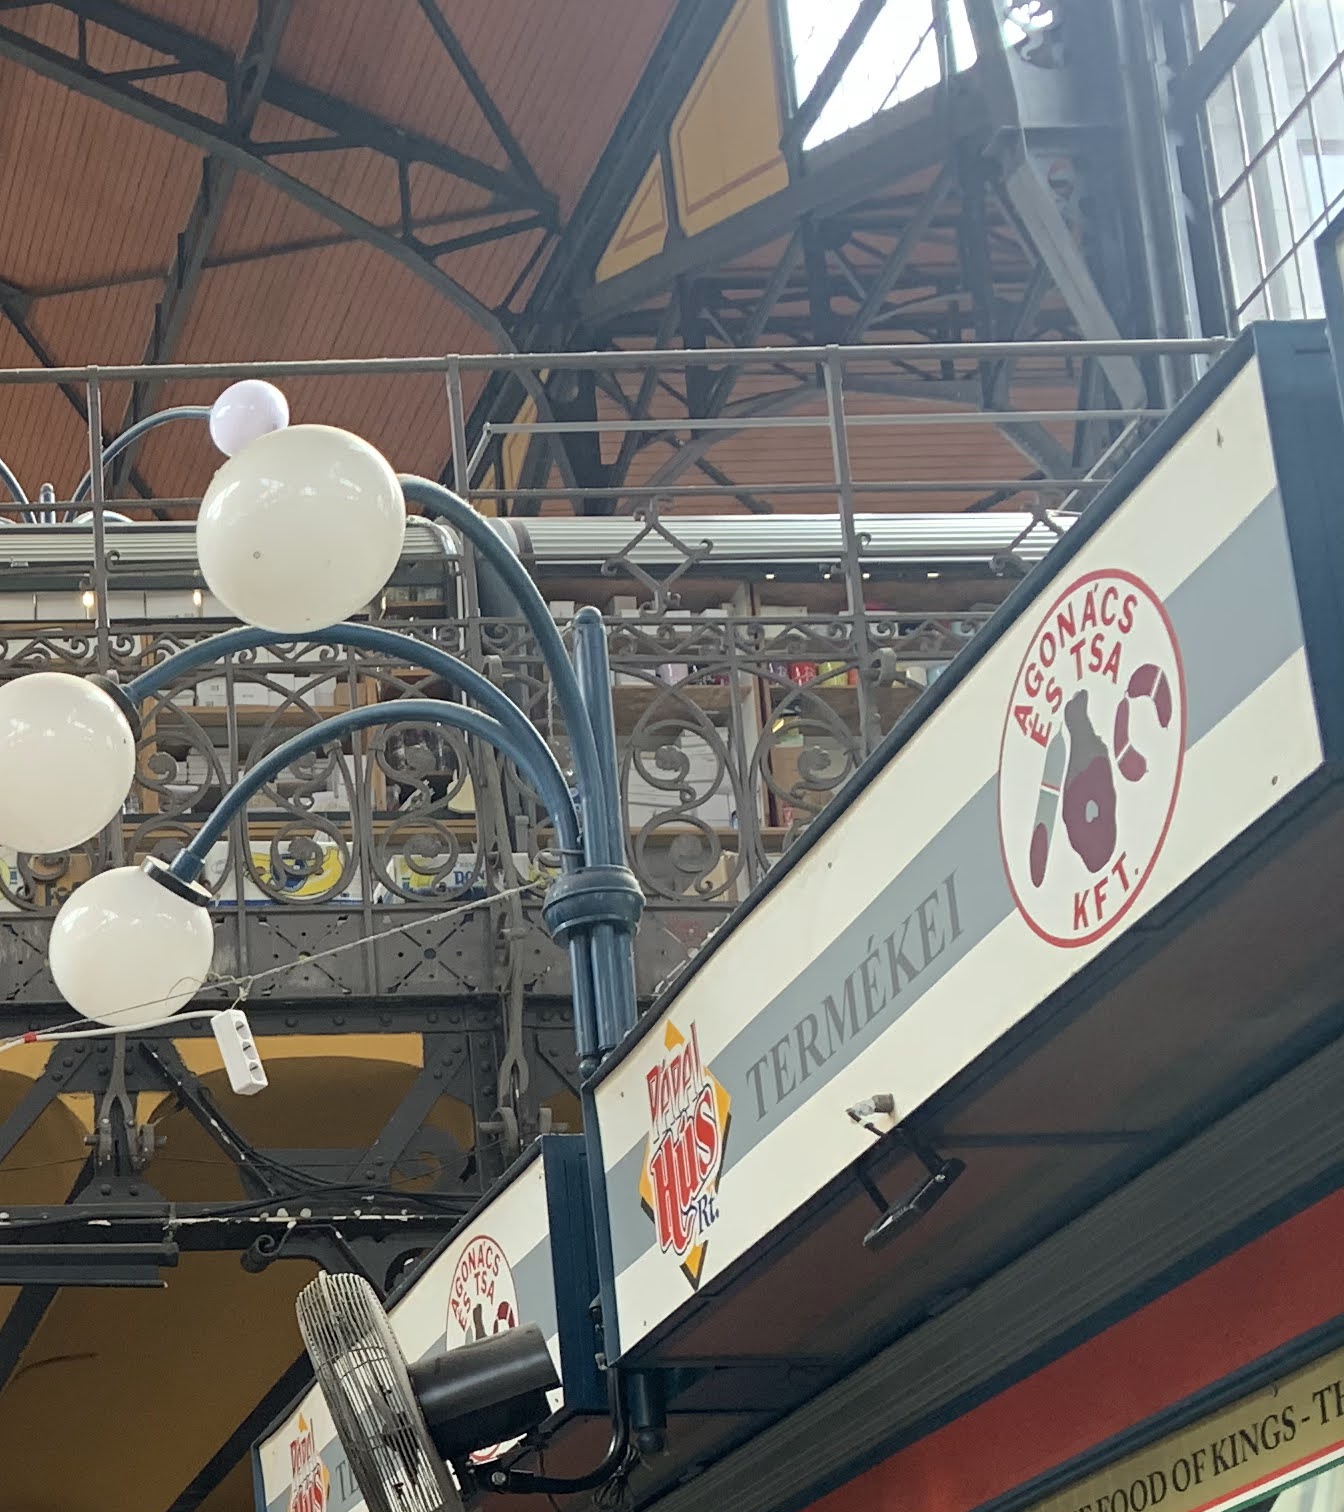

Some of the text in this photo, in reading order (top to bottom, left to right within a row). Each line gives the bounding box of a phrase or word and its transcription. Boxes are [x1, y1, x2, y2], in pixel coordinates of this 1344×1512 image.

[1069, 632, 1123, 685] TSA
[1073, 850, 1139, 931] KFT.
[745, 867, 965, 1123] TERMÉKEI
[697, 1196, 721, 1235] Rt.
[473, 1270, 496, 1306] TSA
[1170, 1450, 1207, 1493] OF
[1211, 1405, 1298, 1477] KINGS
